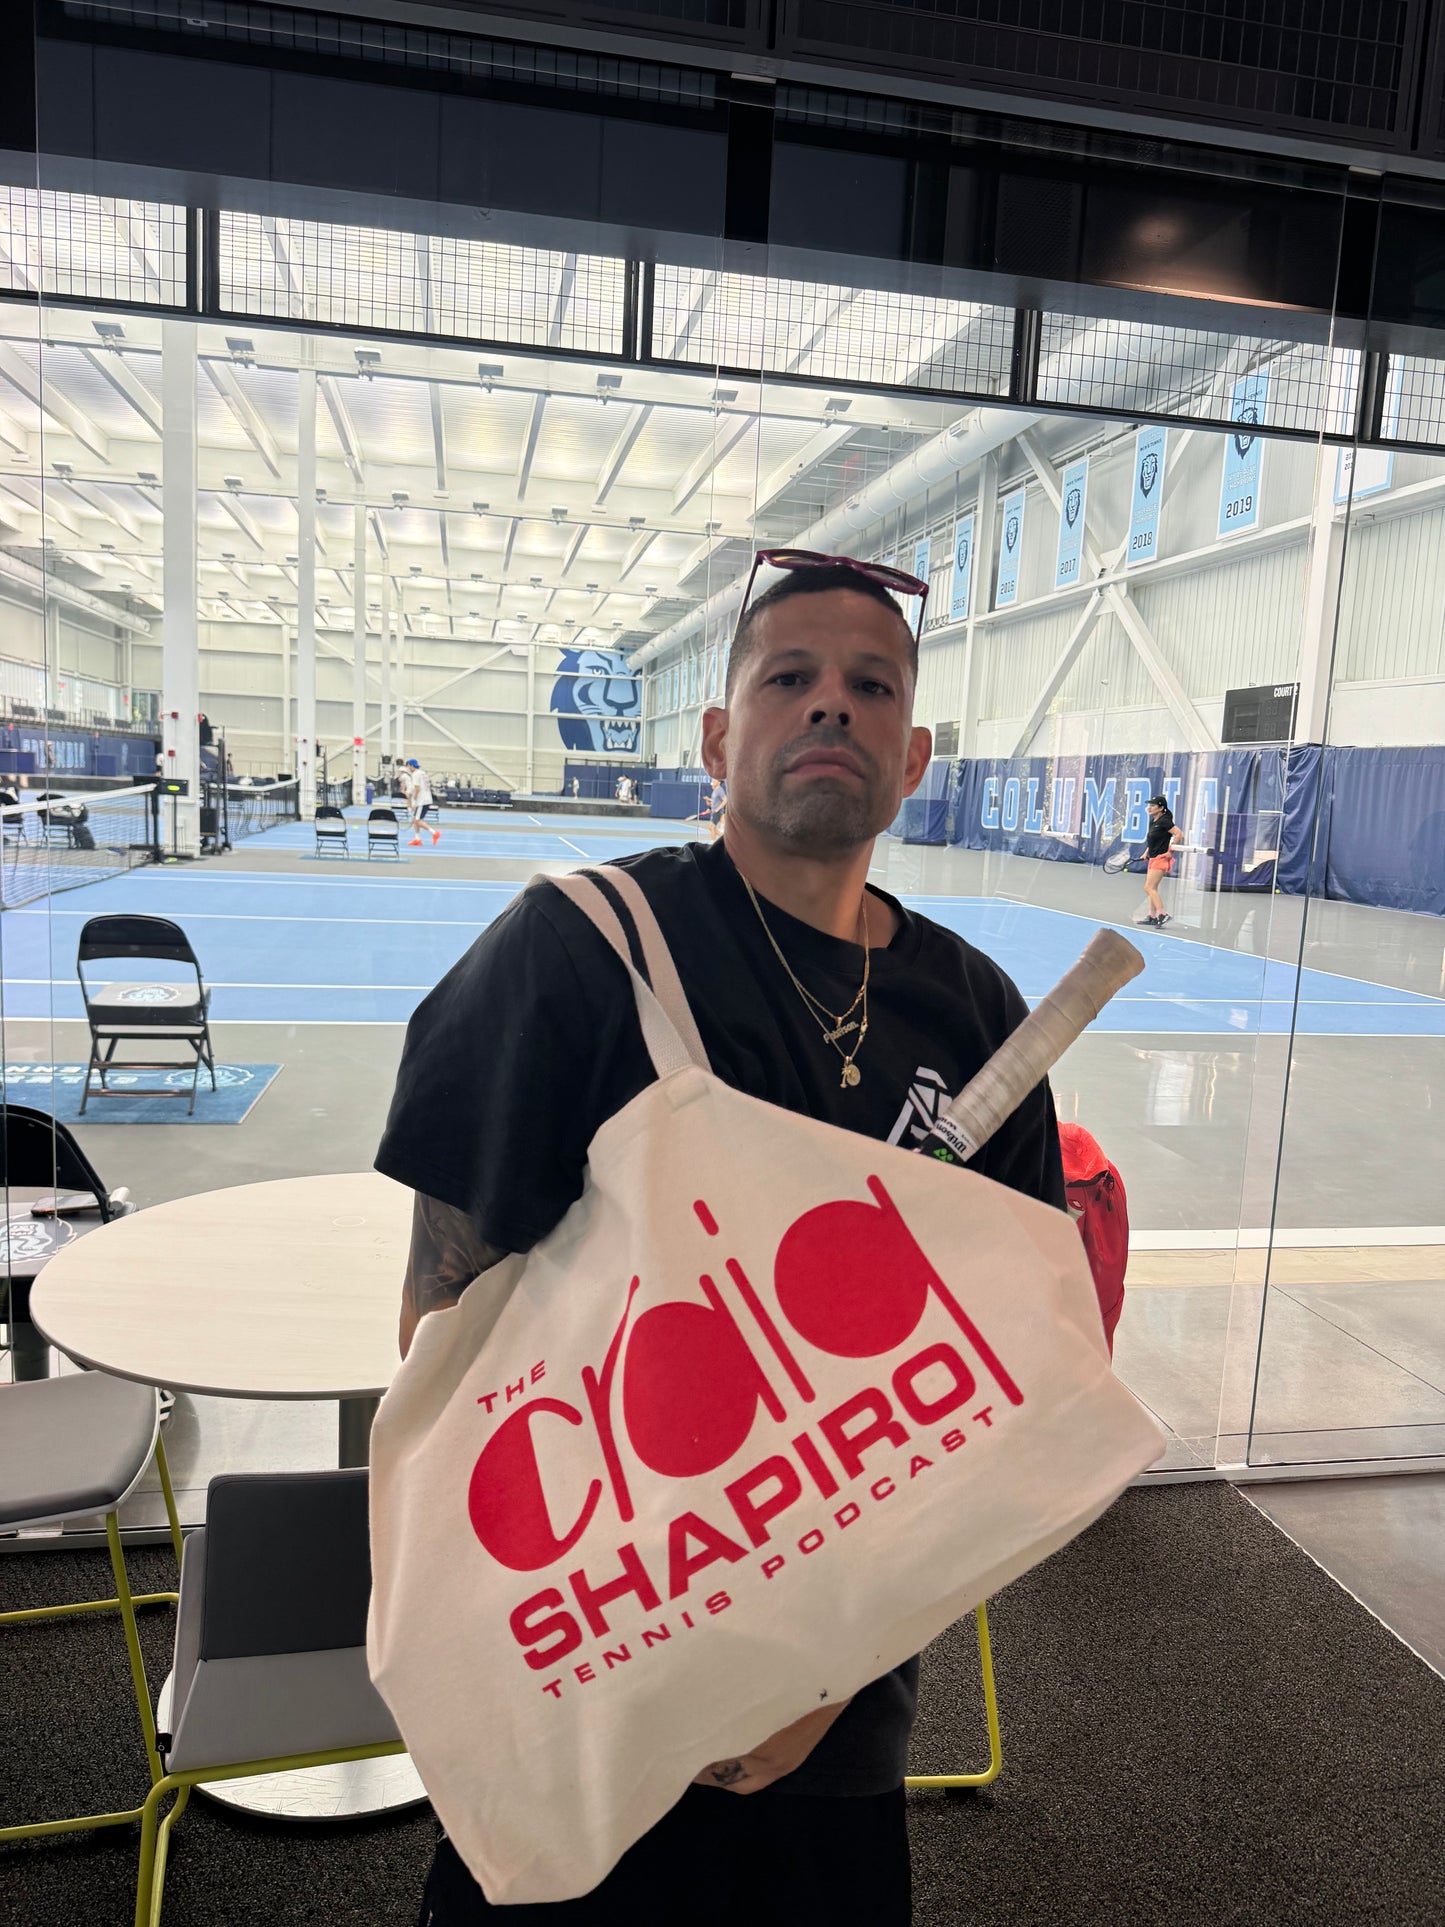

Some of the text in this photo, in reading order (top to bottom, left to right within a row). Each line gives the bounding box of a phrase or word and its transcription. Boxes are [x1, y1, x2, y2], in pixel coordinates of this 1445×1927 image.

[1226, 496, 1252, 518] 2019
[1132, 532, 1153, 550] 2018
[1060, 559, 1076, 574] 2017
[1274, 687, 1293, 698] COURT
[936, 1123, 967, 1154] Wilson
[468, 1175, 1024, 1572] craig
[477, 1361, 546, 1414] THE
[509, 1343, 977, 1671] SHAPIRO
[543, 1407, 993, 1698] TENNIS PODCAST
